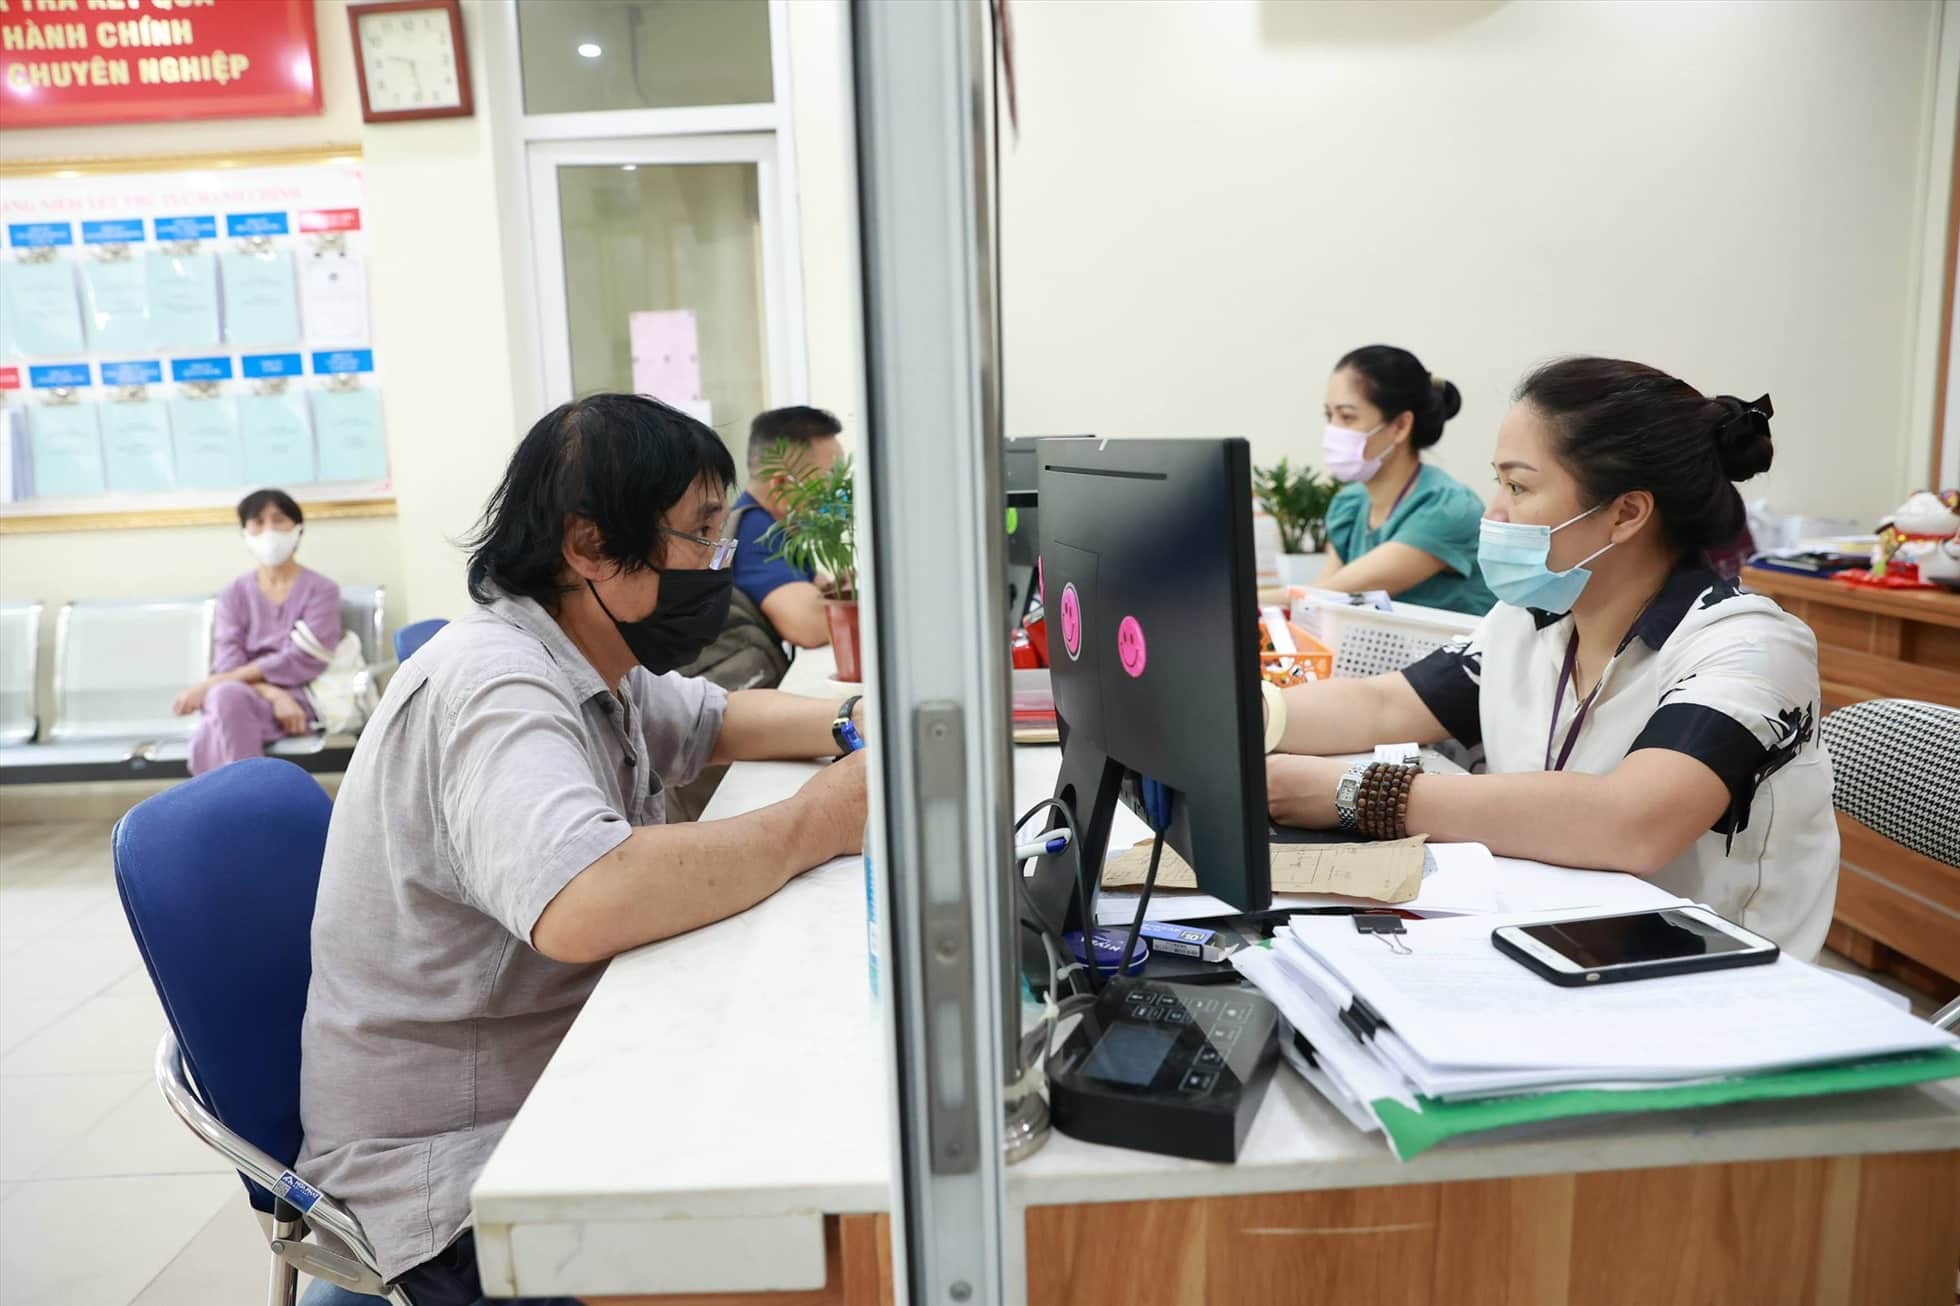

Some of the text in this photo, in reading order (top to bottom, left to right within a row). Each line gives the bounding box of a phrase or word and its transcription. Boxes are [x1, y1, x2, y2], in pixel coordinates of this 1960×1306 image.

[2, 14, 194, 50] HÀNH CHÍNH
[7, 49, 249, 87] CHUYÊN NGHIỆP
